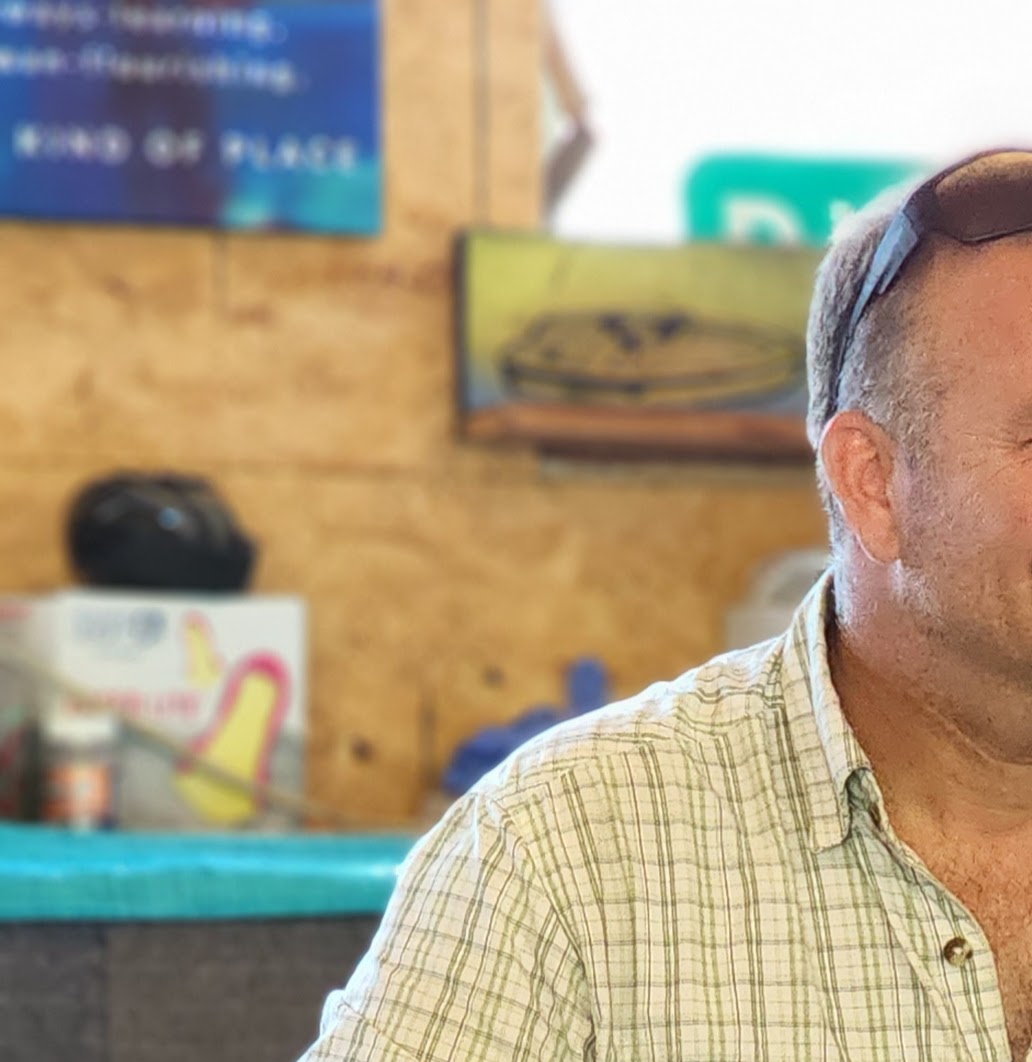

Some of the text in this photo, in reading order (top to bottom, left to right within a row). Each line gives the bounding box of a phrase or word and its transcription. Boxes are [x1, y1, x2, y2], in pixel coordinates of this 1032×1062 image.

[13, 122, 358, 178] KIND OF PLACE
